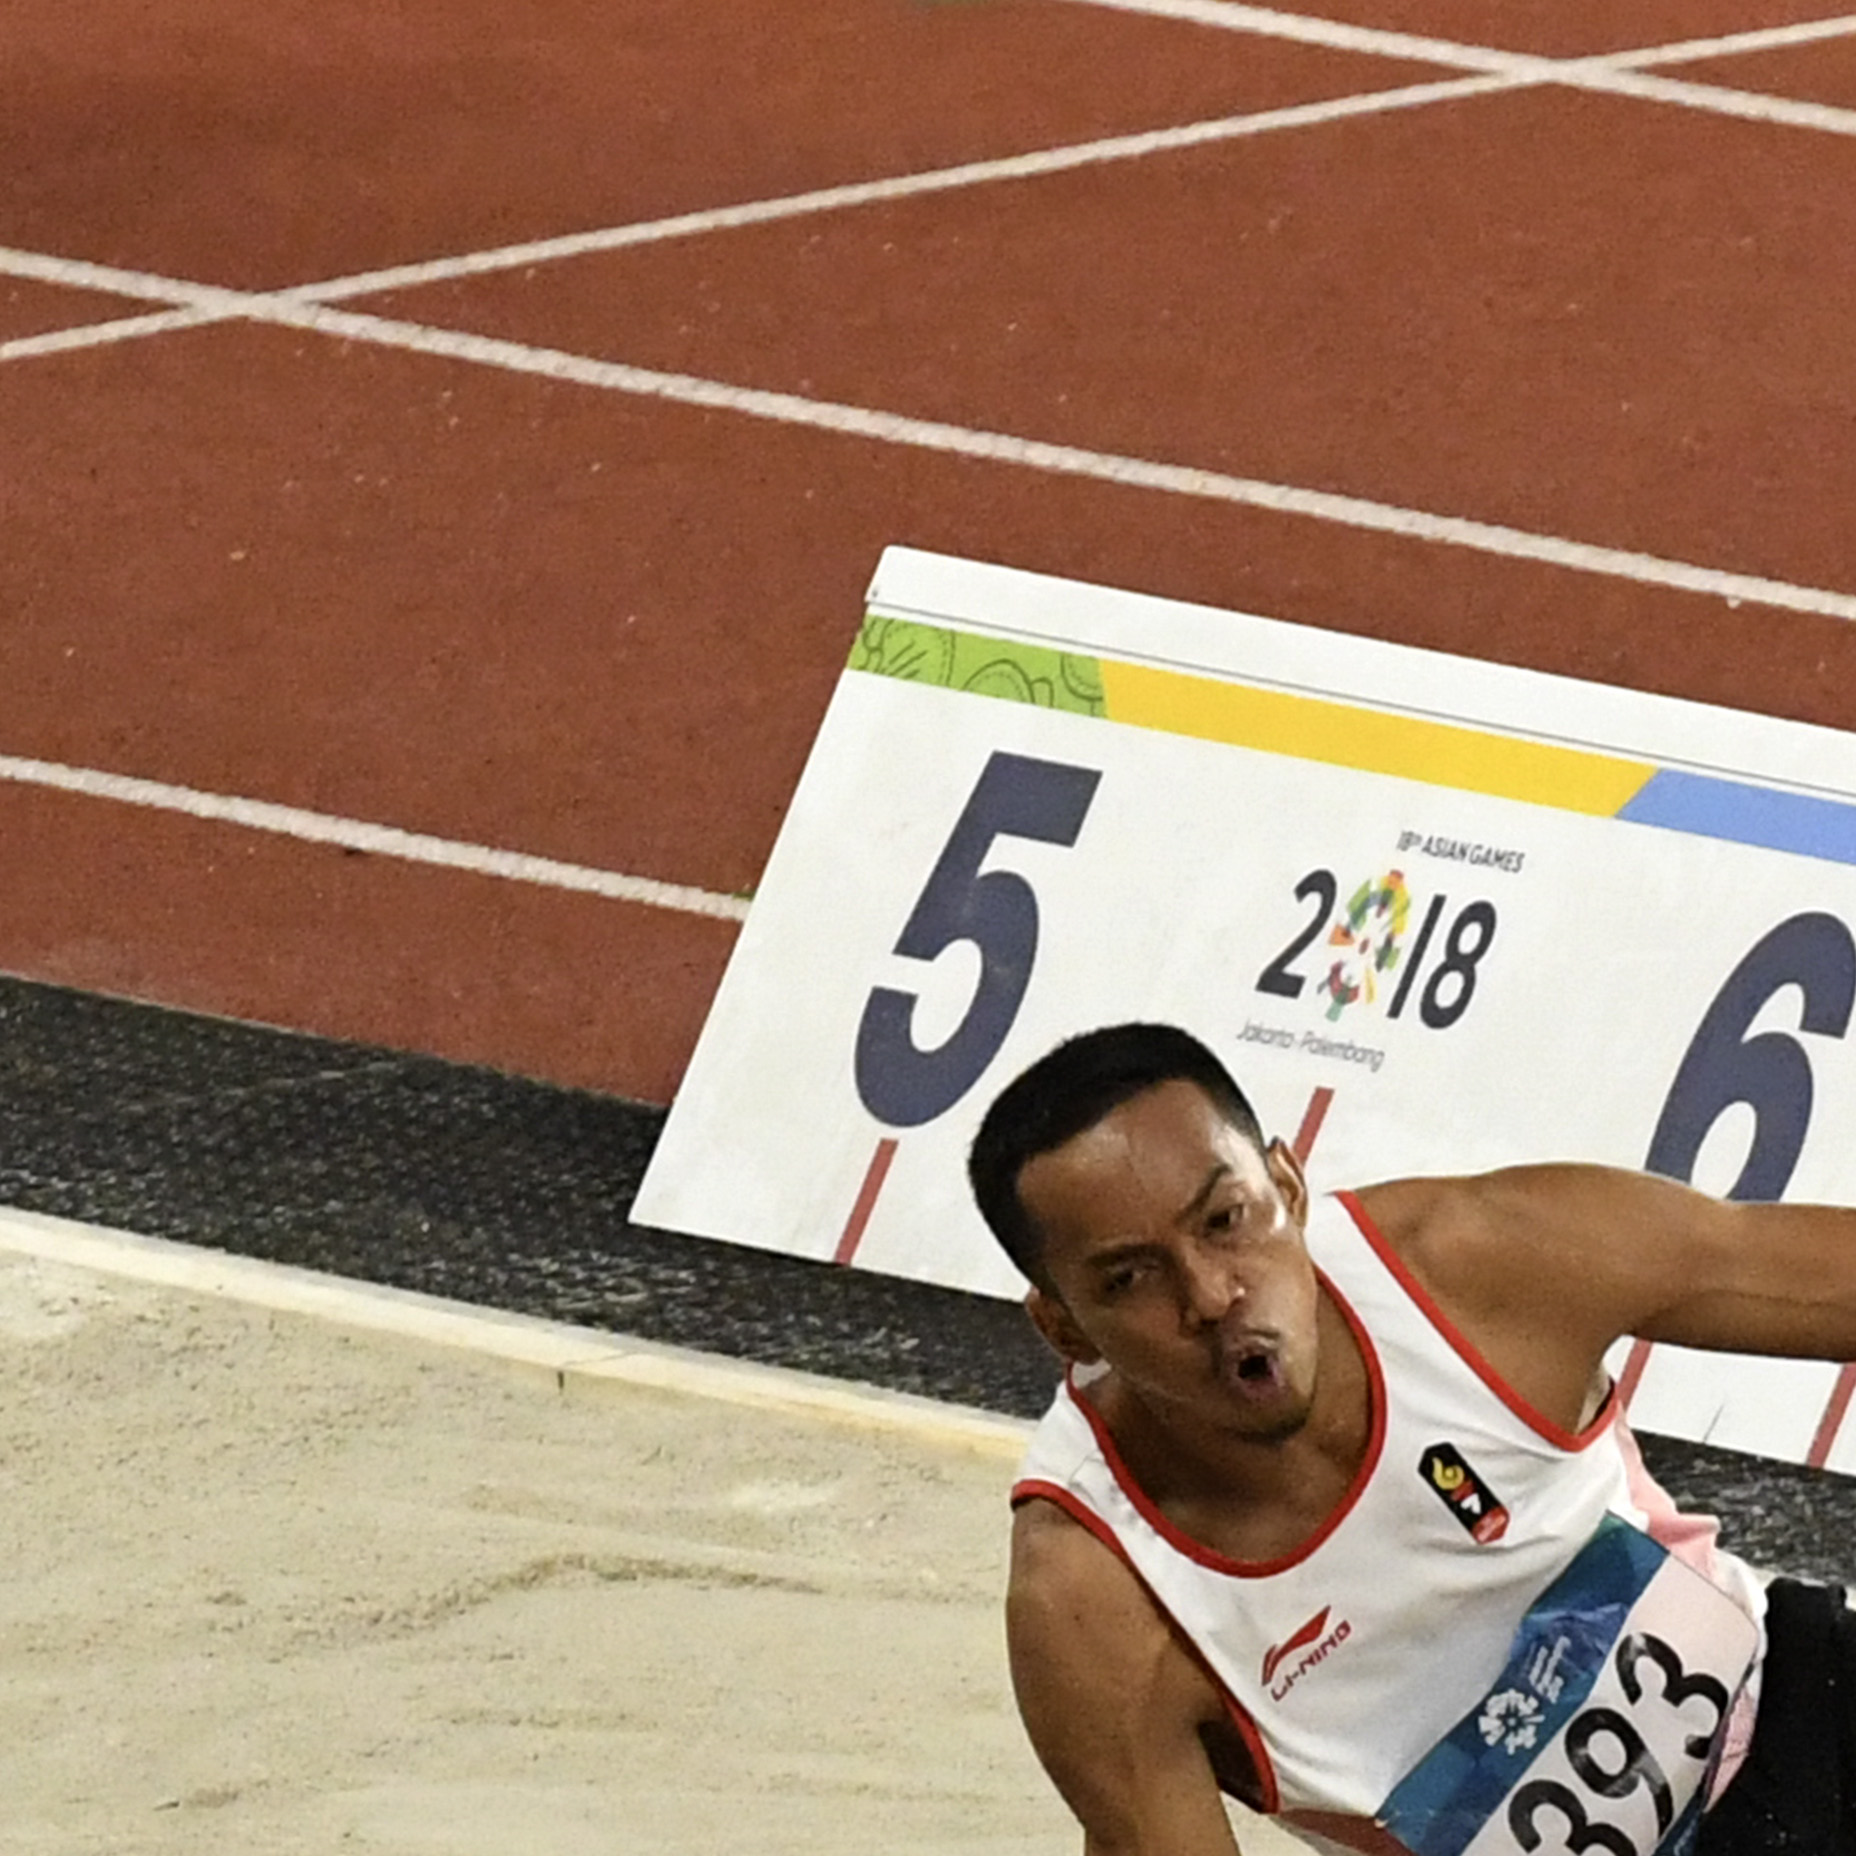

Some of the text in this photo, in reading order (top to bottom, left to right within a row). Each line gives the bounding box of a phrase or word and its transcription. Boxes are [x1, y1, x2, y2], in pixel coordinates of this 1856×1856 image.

[855, 751, 1102, 1128] 5
[1421, 834, 1471, 862] ASIAN
[1467, 842, 1526, 874] GAMES
